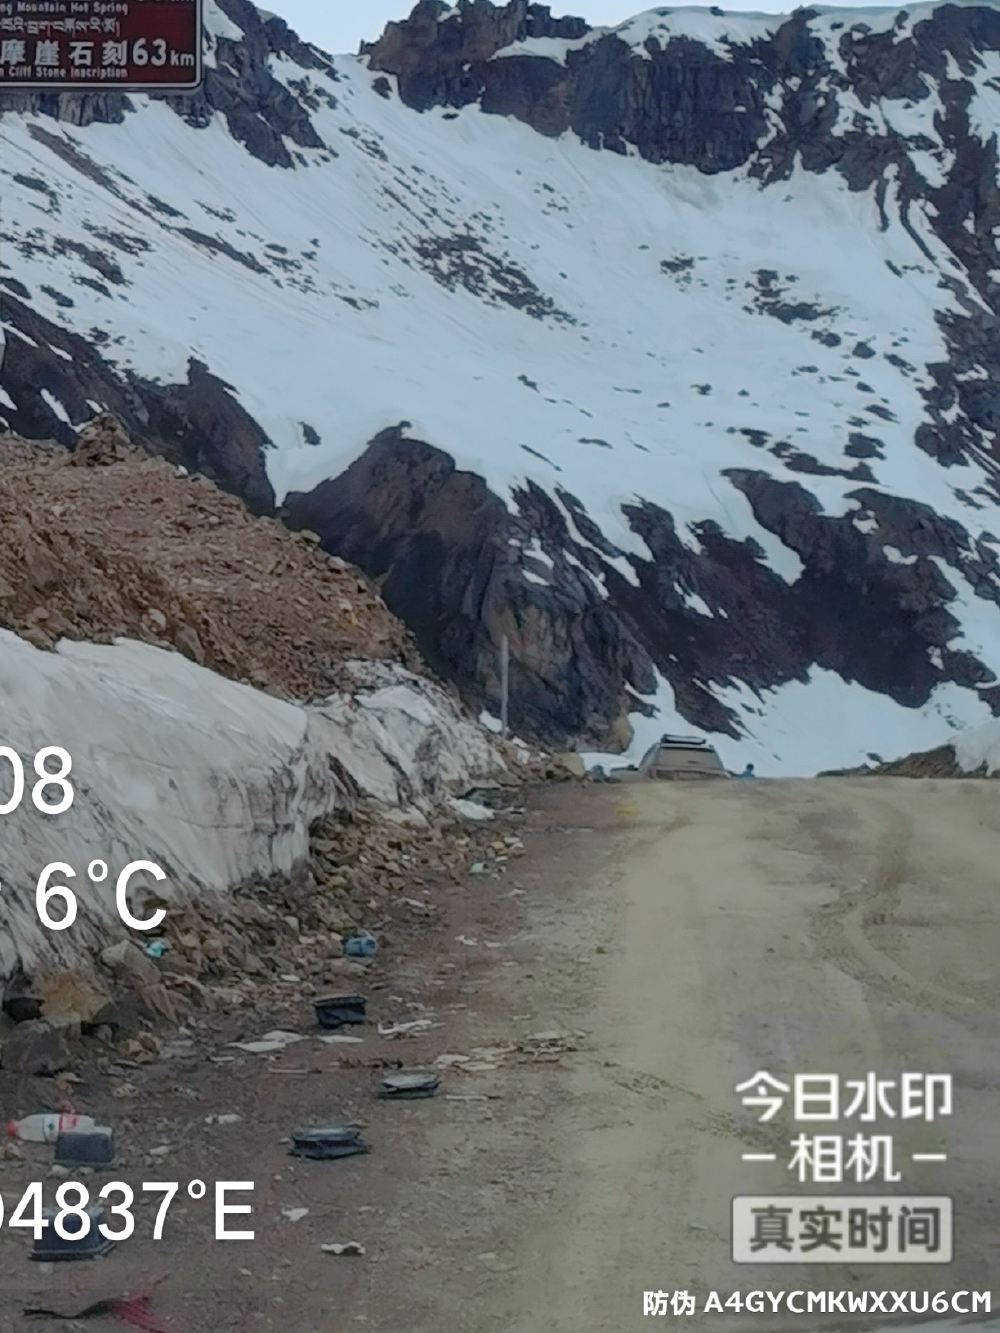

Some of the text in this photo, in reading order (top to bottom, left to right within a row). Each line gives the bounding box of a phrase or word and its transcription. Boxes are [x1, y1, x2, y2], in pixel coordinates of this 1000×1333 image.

[17, 2, 66, 12] Mountain
[71, 2, 89, 13] Hot
[93, 1, 128, 16] Spring
[9, 66, 32, 77] Cliff
[35, 66, 66, 77] Stone
[70, 66, 128, 79] Inscription
